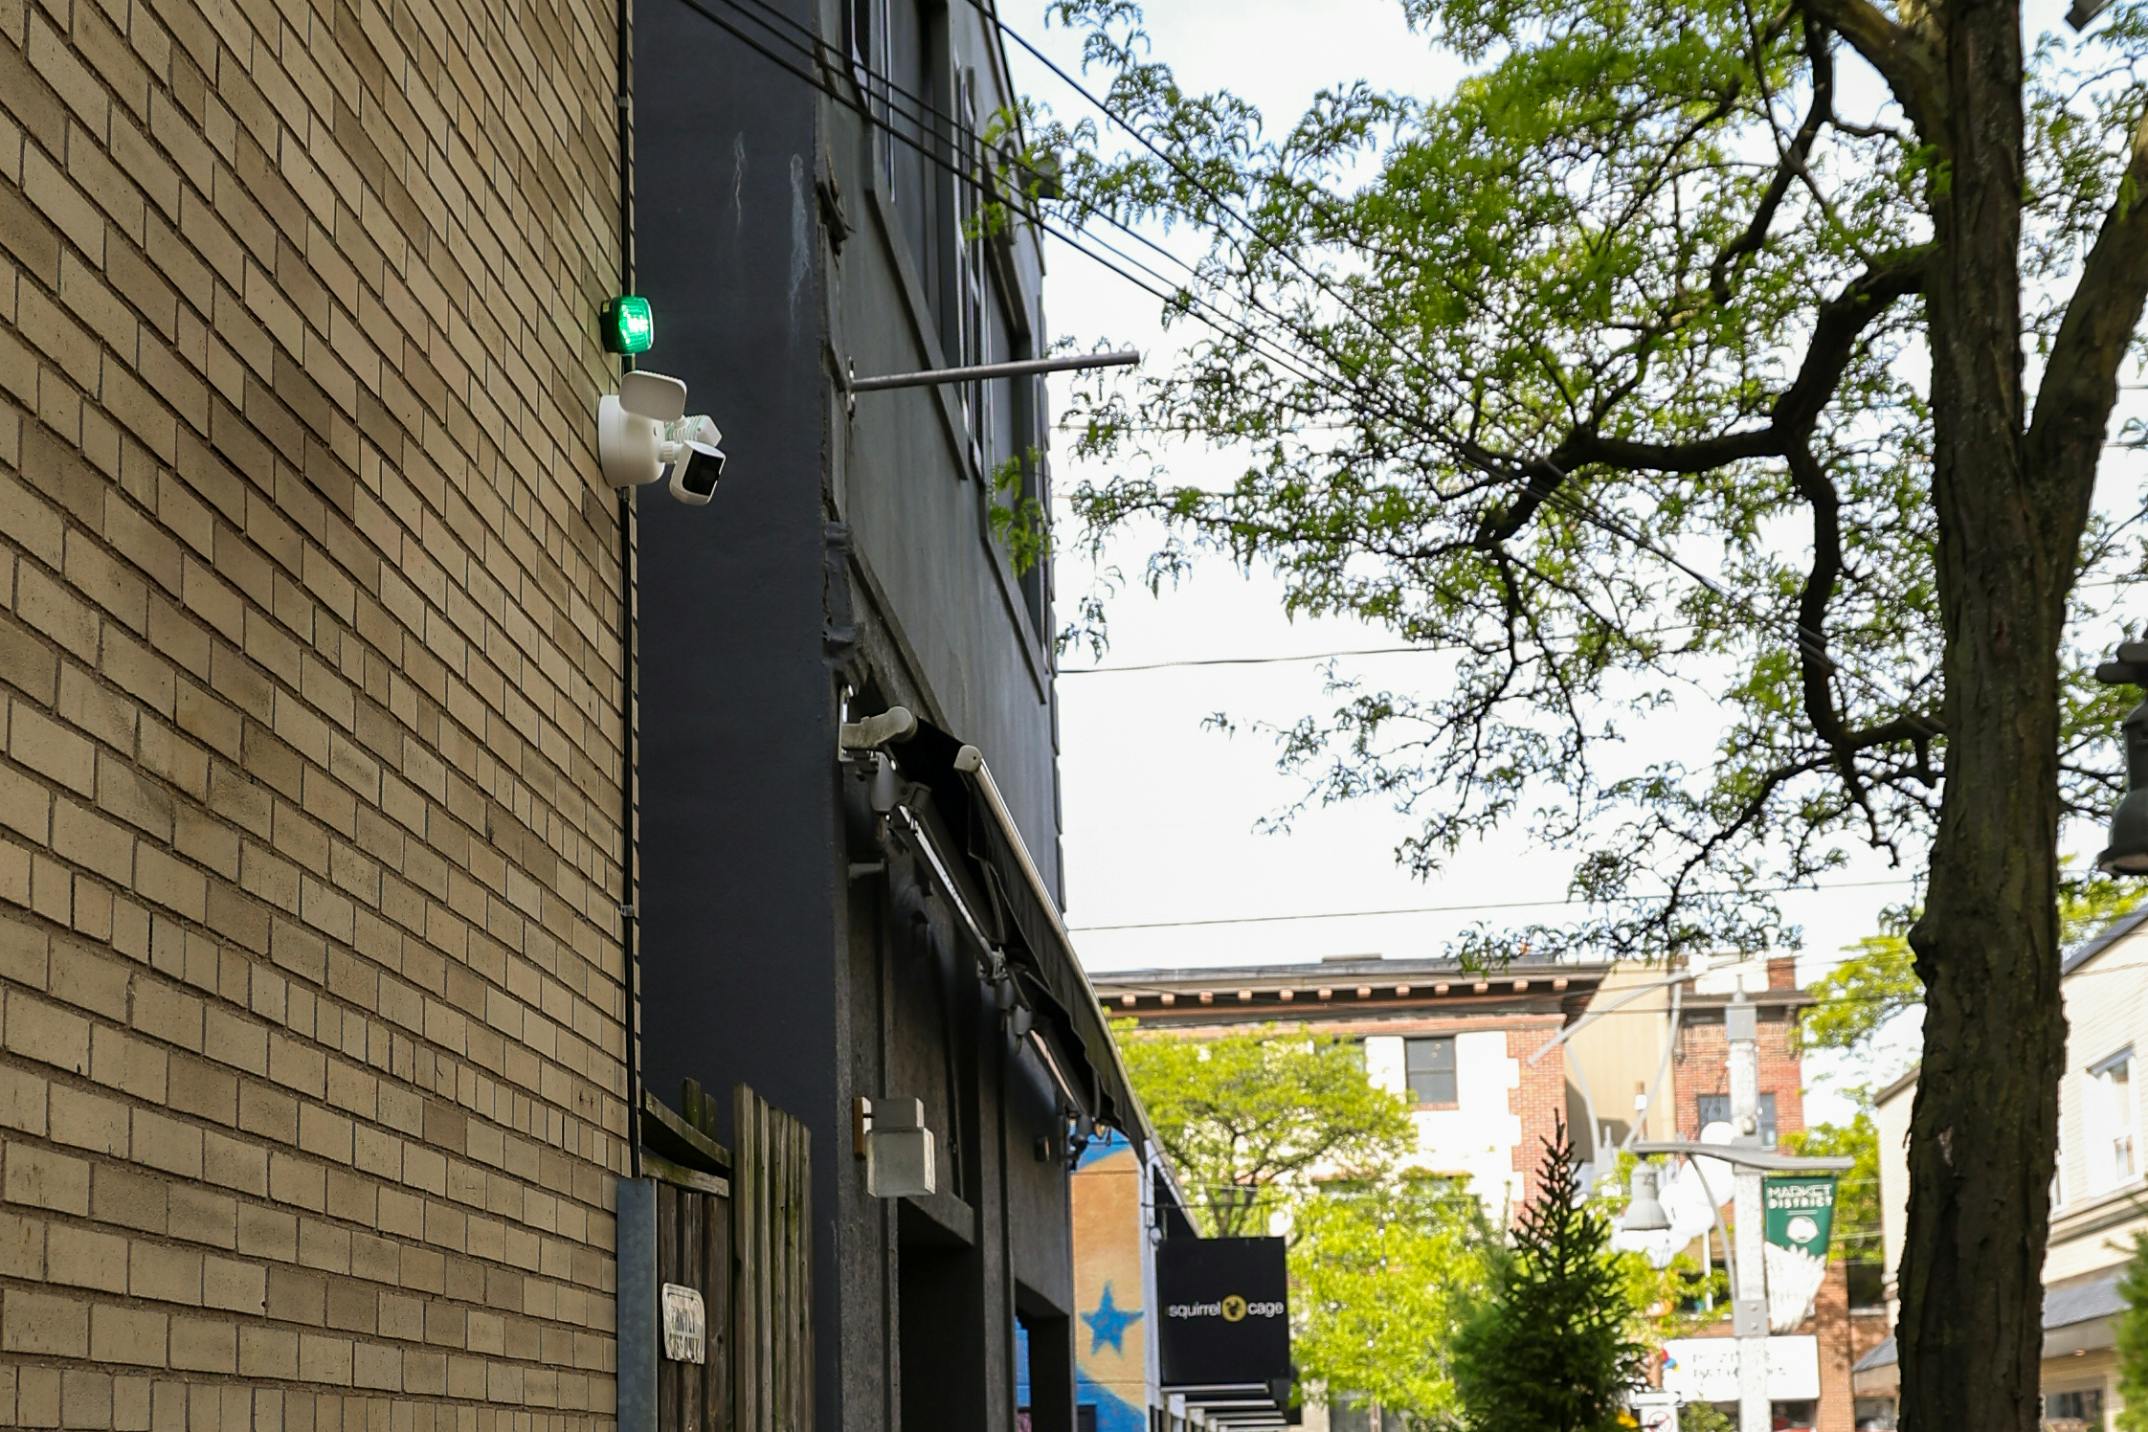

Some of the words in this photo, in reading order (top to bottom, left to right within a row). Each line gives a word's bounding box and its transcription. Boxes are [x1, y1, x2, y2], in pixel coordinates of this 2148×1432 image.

[1767, 1184, 1833, 1198] MARKET
[1767, 1196, 1833, 1209] DISTRICT
[1168, 1301, 1221, 1320] squirrel
[1247, 1302, 1284, 1318] cage
